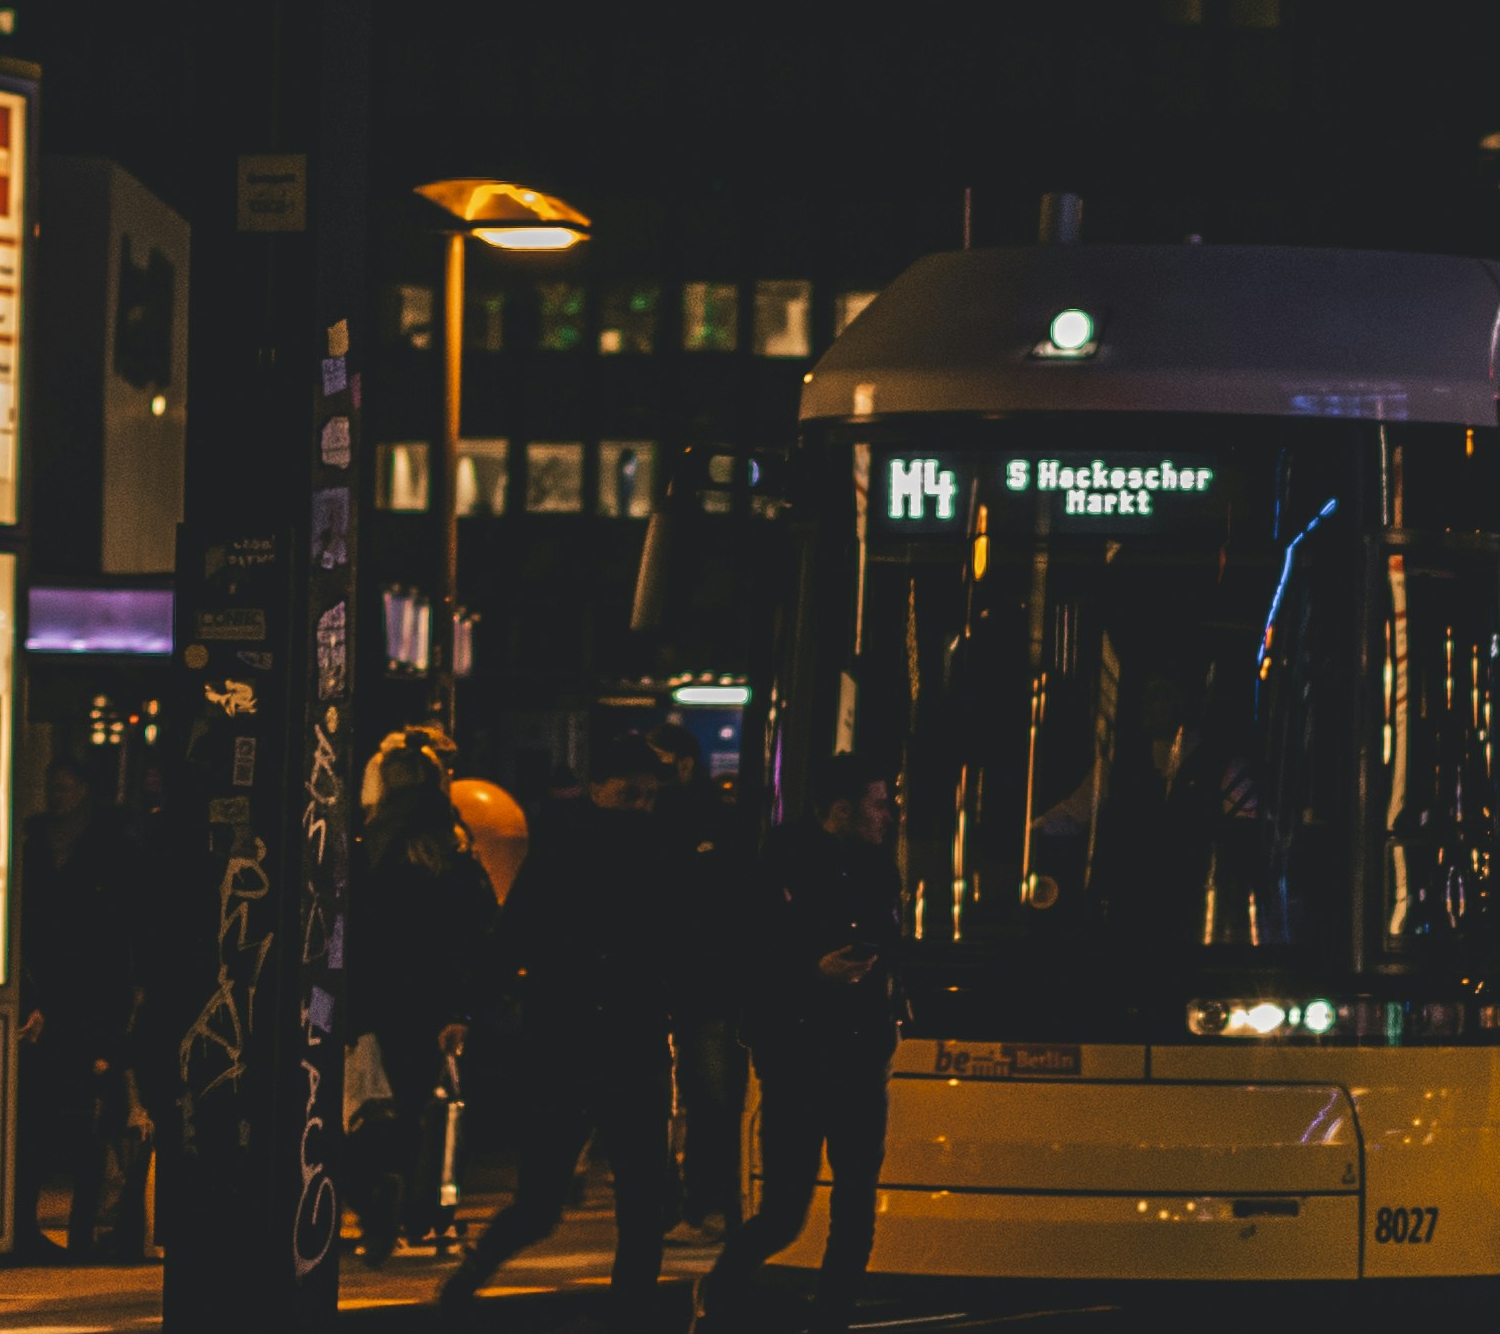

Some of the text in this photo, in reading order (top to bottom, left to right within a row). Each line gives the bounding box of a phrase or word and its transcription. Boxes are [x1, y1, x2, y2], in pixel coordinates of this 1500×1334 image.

[889, 459, 956, 519] M4
[1006, 460, 1214, 491] S Hackescher
[1065, 489, 1152, 516] Markt
[1375, 1206, 1438, 1244] 8027
